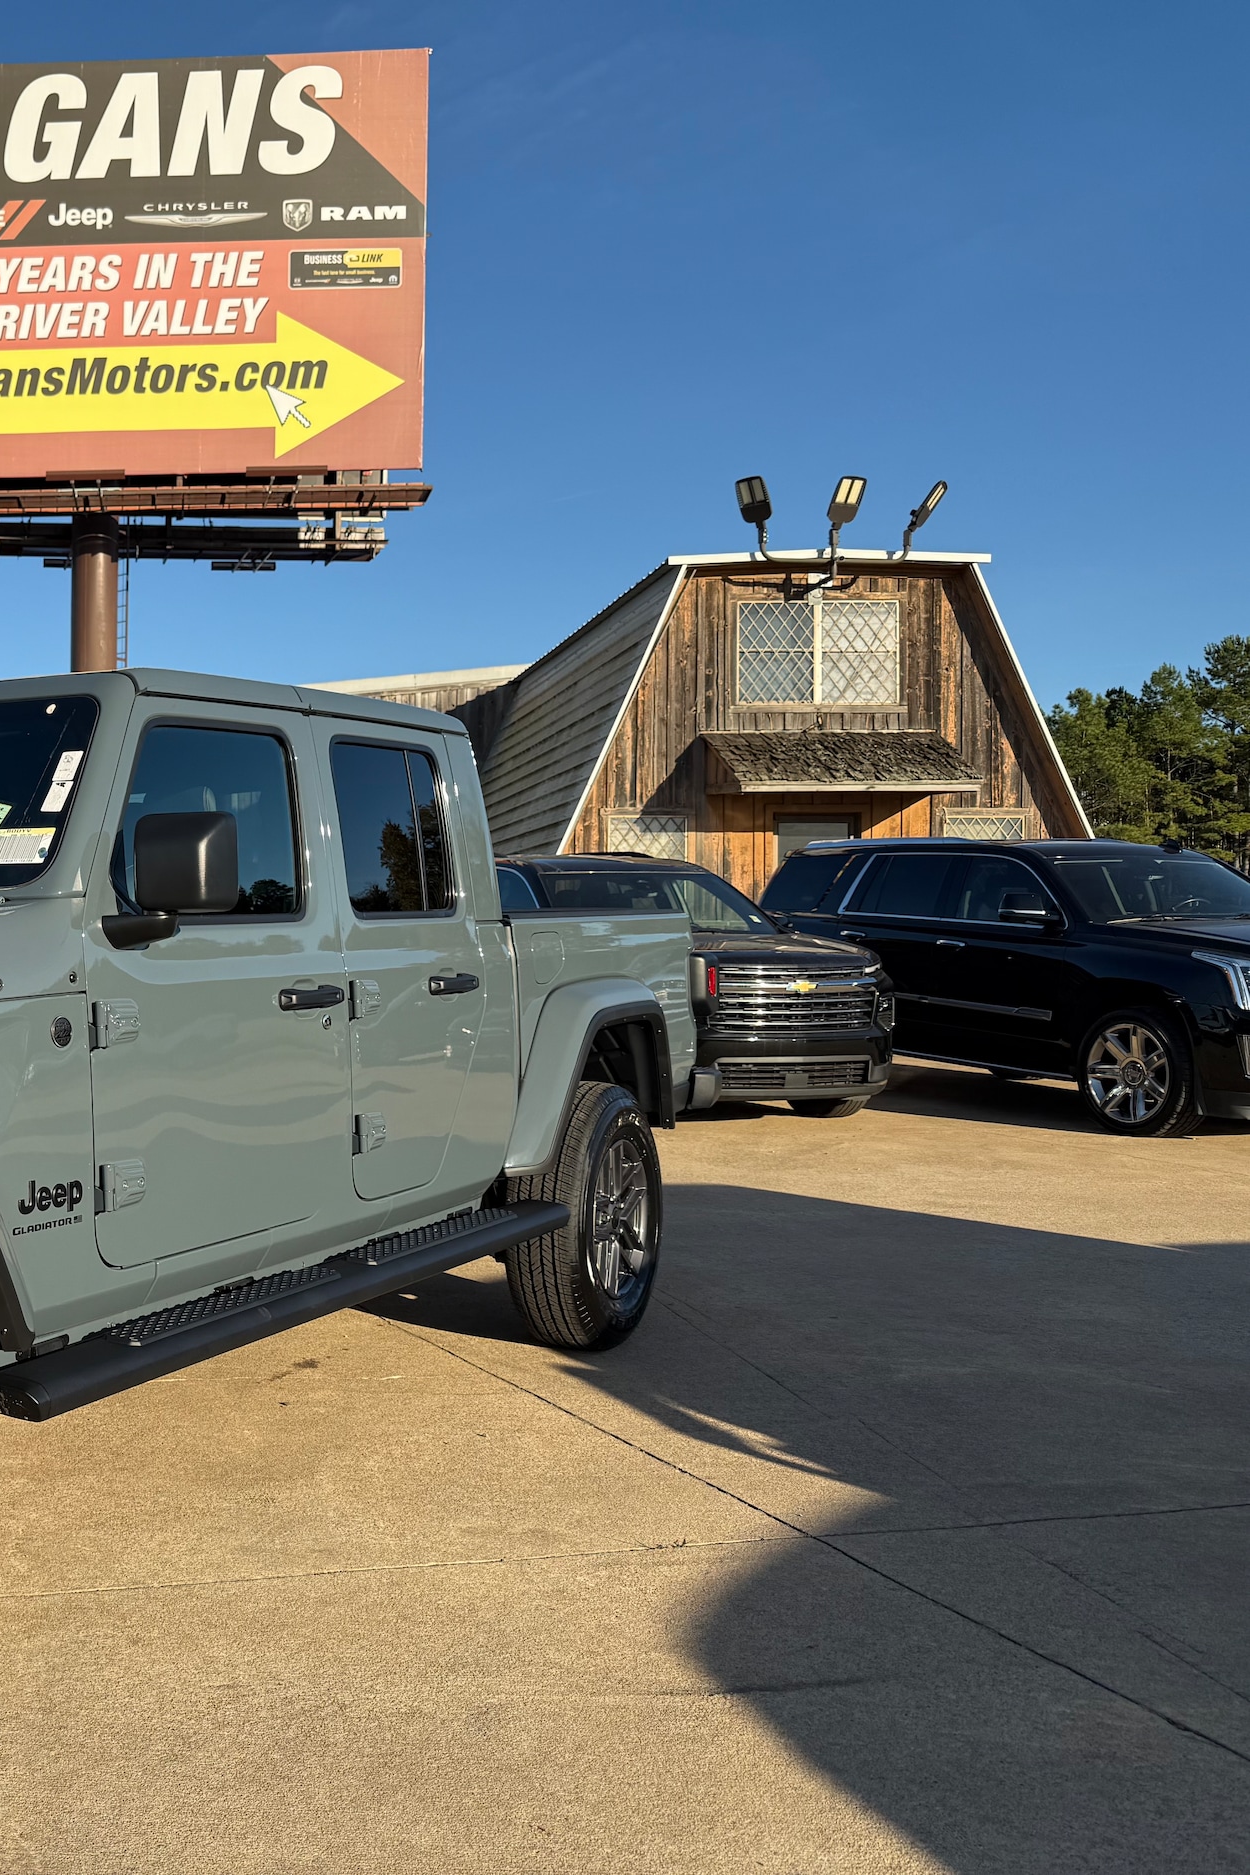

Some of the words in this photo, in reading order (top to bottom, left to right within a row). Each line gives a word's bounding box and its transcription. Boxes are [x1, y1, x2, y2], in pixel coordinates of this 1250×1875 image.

[48, 203, 113, 229] Jeep
[143, 201, 249, 211] CHRYSLER
[320, 205, 407, 221] RAM
[132, 252, 178, 289] IN
[190, 250, 265, 288] THE
[303, 254, 342, 265] BUSINESS
[361, 253, 383, 263] LINK
[122, 297, 270, 337] VALLEY
[17, 1180, 84, 1215] Jeep
[12, 1217, 73, 1236] GLADIATOR
